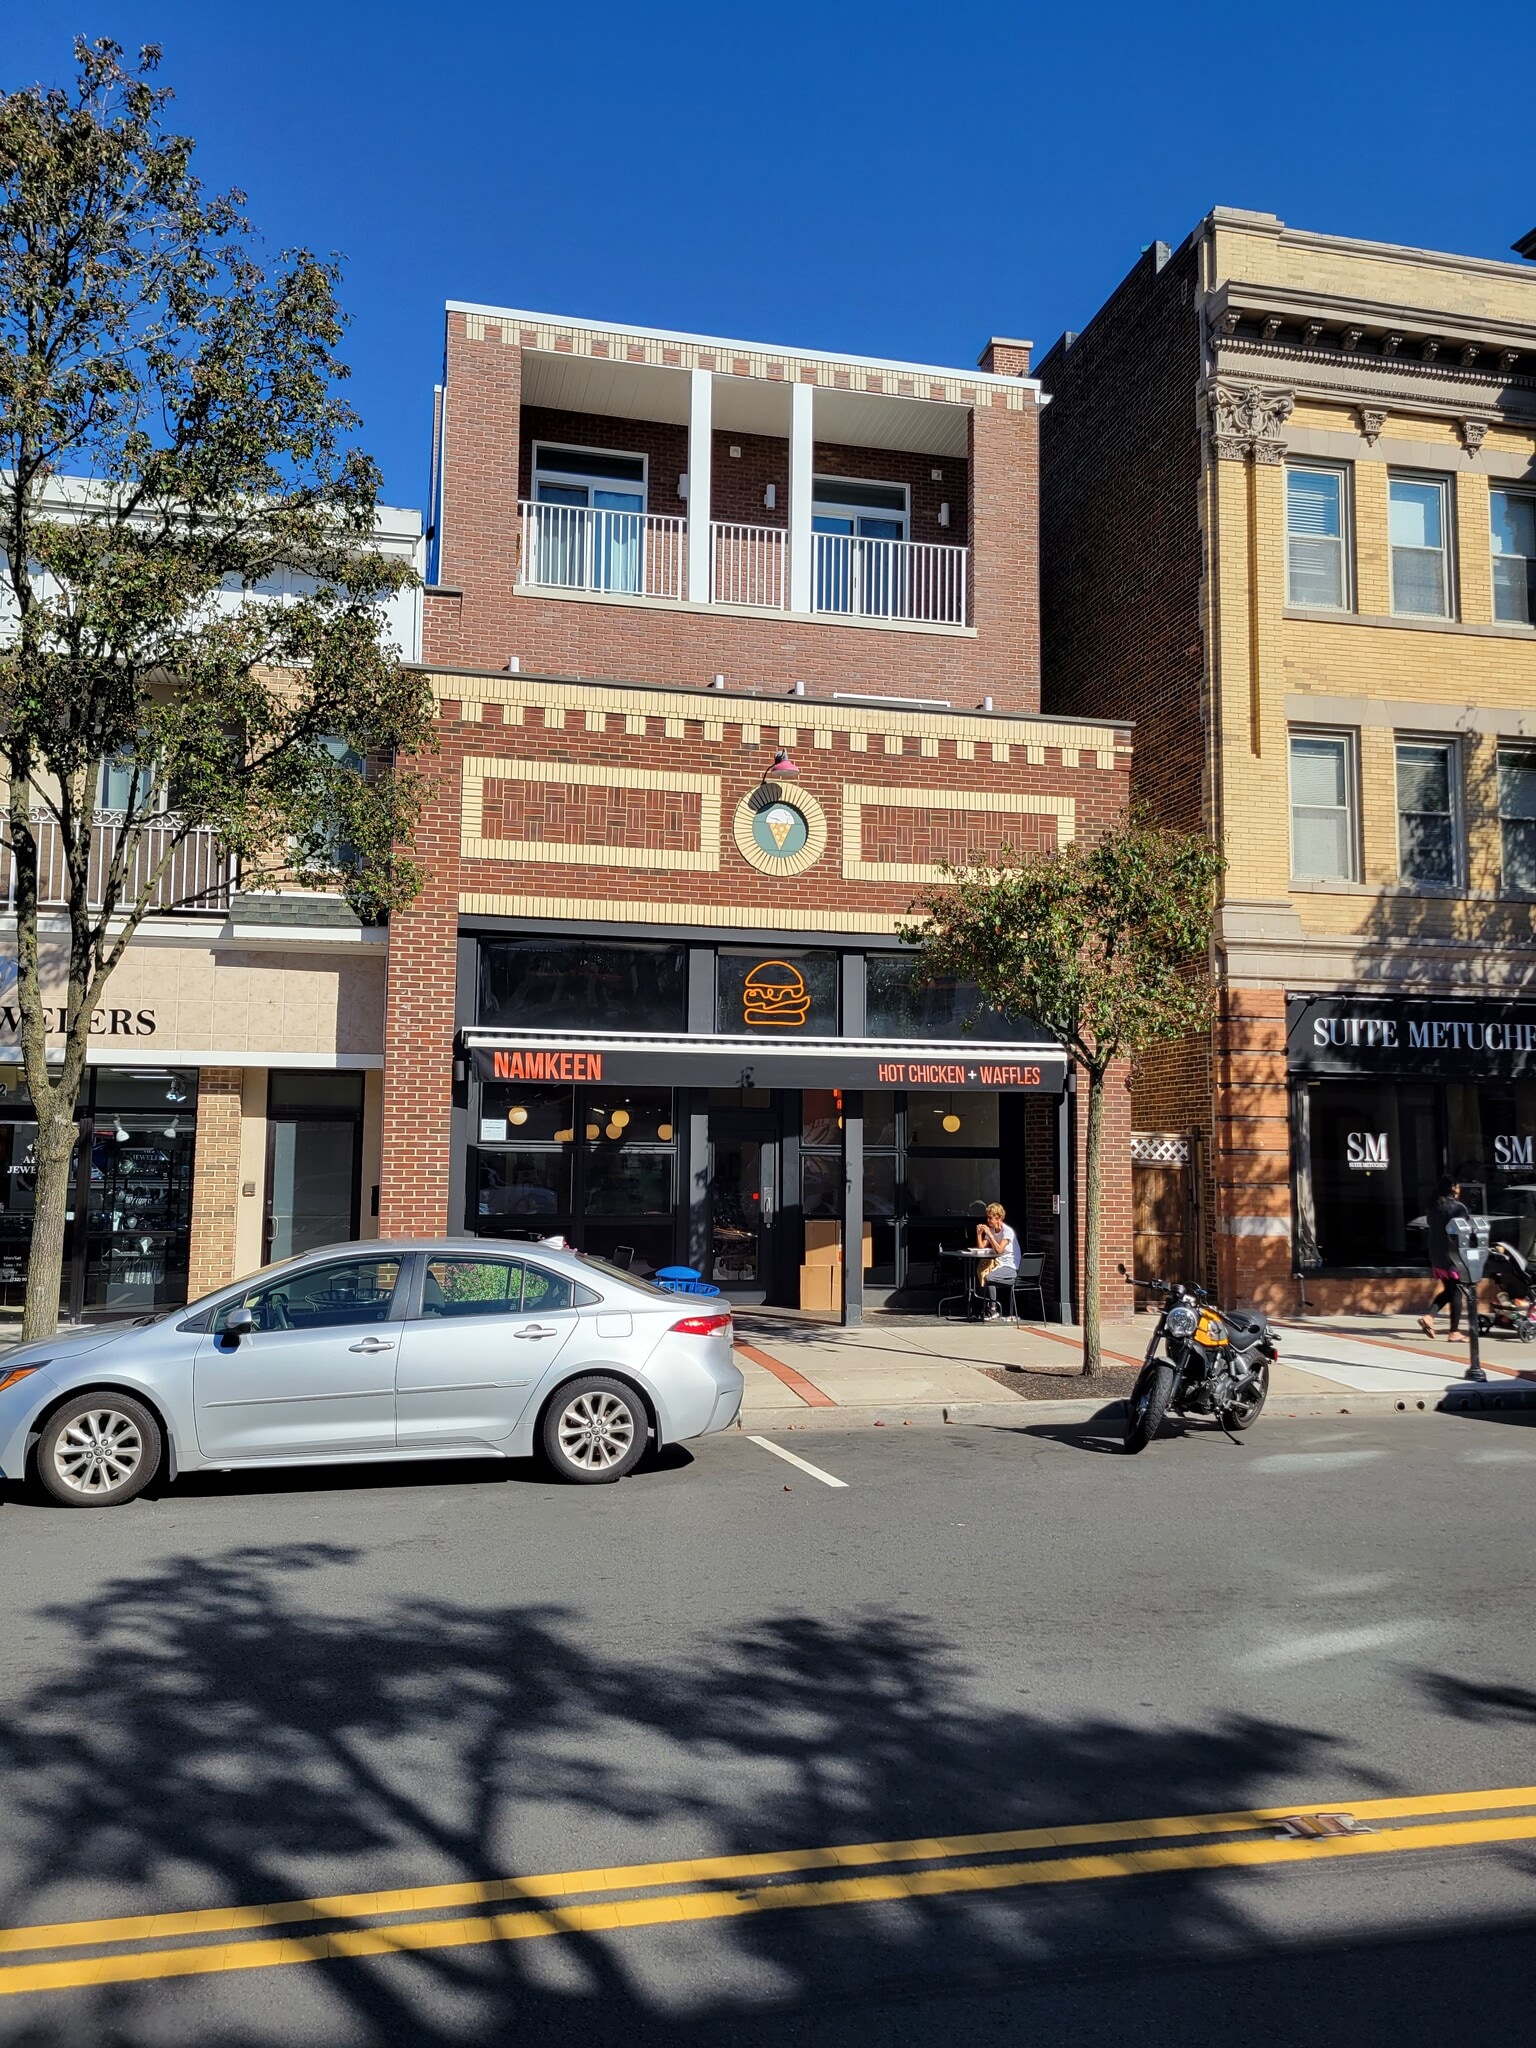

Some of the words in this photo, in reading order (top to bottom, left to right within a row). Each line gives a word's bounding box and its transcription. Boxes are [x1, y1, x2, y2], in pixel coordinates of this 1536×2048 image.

[1313, 1017, 1399, 1048] SUITE
[1407, 1020, 1536, 1051] METUCHE
[494, 1051, 602, 1081] NAMKEEN
[878, 1063, 905, 1082] HOT
[908, 1063, 965, 1084] CHICKEN
[967, 1069, 977, 1080] +
[979, 1066, 1041, 1085] WAFFLES
[1347, 1132, 1389, 1162] SM
[1494, 1134, 1534, 1164] SM
